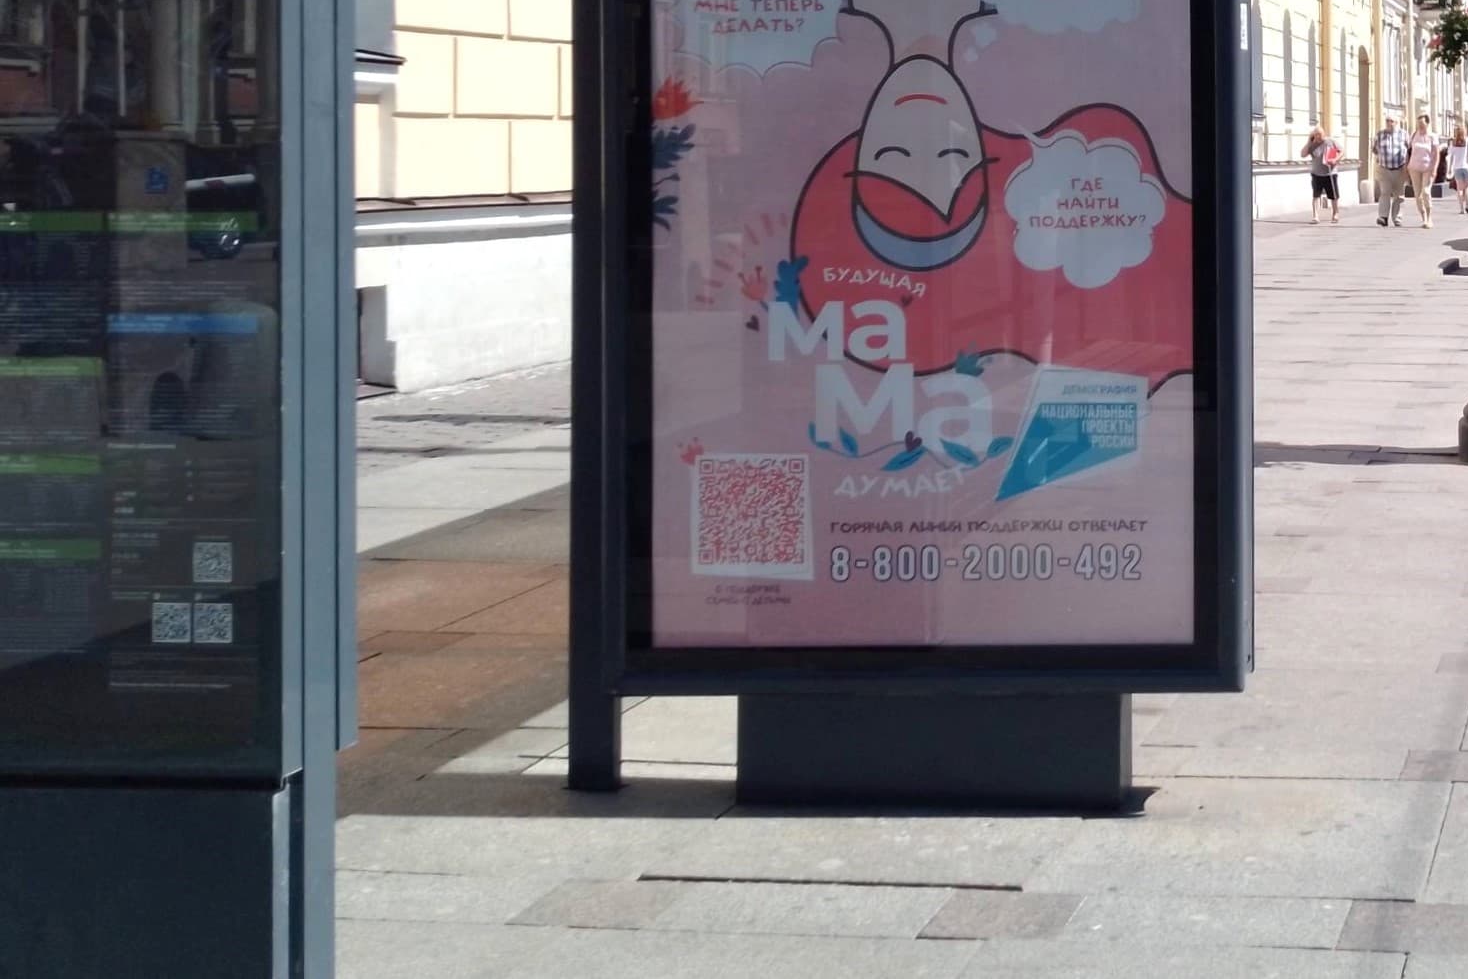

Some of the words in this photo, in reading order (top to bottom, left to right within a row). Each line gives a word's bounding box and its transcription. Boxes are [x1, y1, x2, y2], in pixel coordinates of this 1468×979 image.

[712, 17, 805, 33] ДЕЛАТЬ?
[1071, 177, 1104, 192] ГДЕ
[1057, 194, 1120, 210] НАЙТИ
[1029, 214, 1146, 229] ПОДДЕРЖКУ?
[823, 267, 926, 298] БУДУЩАЯ
[1041, 404, 1135, 419] НАЦИОНАЛЬНЫЕ
[1081, 419, 1136, 433] ПРОЕКТЫ
[1091, 434, 1136, 448] РОССИИ
[834, 464, 965, 498] ДУМАЕТ
[830, 521, 902, 534] ГОРЯЧАЯ
[909, 520, 962, 533] ЛИНИЯ
[967, 520, 1062, 534] ПОДДЕРЖКИ
[1068, 520, 1148, 533] ОТВЕЧАЕТ
[830, 544, 1143, 582] 8-800-2000-492
